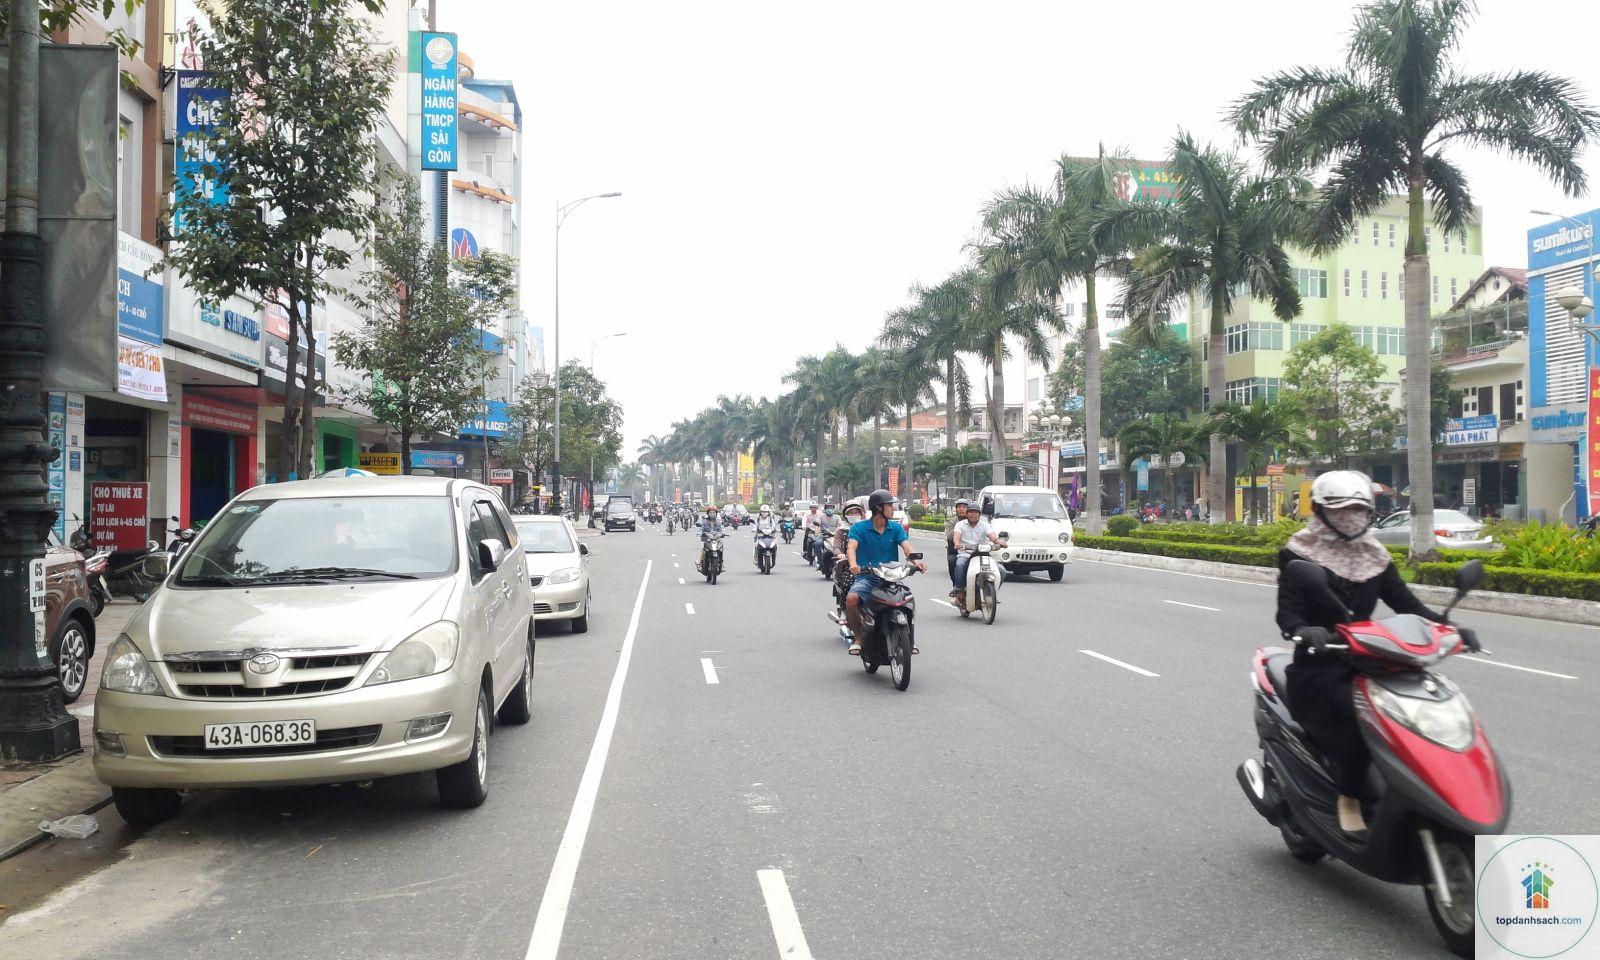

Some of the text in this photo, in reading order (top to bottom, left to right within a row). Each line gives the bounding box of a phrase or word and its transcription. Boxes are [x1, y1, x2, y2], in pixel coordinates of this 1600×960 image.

[424, 75, 454, 91] NGÂN
[424, 92, 455, 109] HÀNG
[424, 113, 454, 127] TMCP
[430, 128, 449, 145] SÀI
[427, 147, 451, 163] GÒN
[1532, 409, 1587, 431] sumikur
[94, 487, 110, 499] CHO
[132, 487, 143, 499] XE
[209, 722, 312, 746] 43A-068.36
